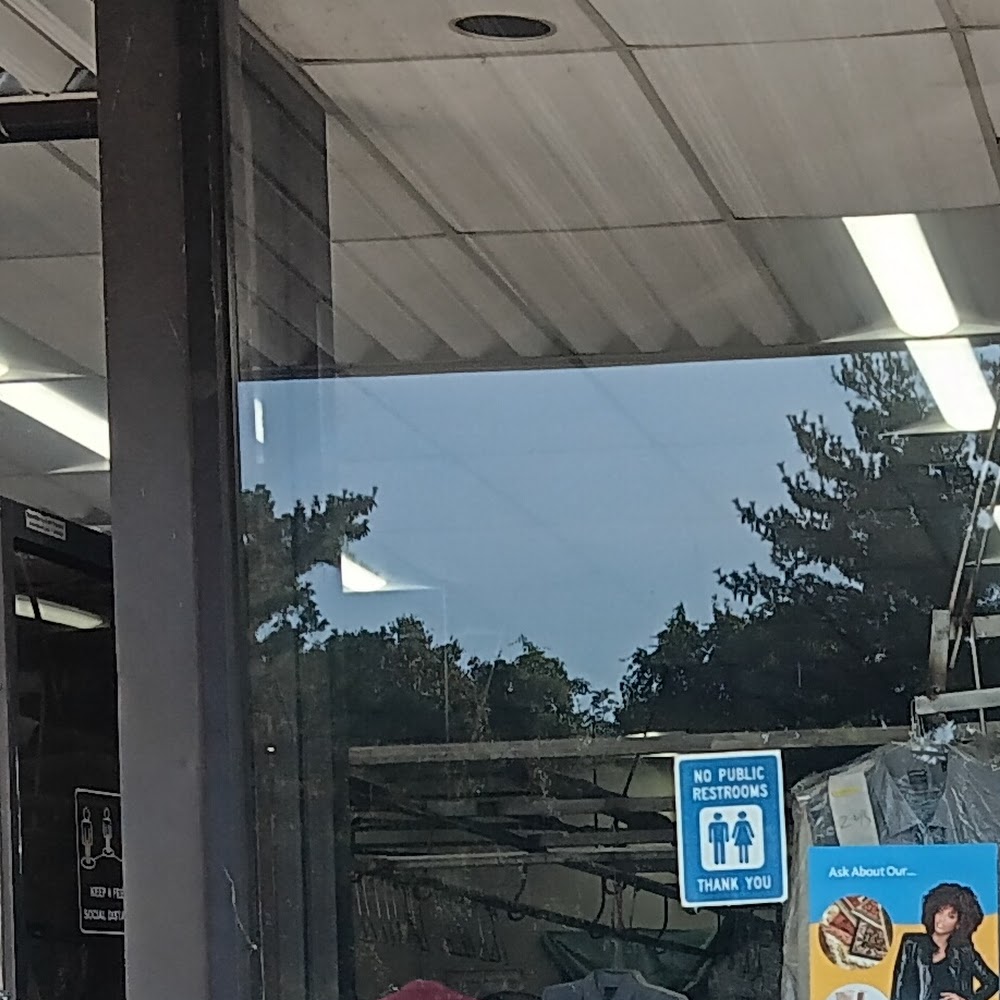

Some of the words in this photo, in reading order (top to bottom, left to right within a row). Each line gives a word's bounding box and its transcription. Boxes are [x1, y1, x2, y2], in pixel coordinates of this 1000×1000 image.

[694, 769, 712, 783] NO
[718, 766, 765, 782] PUBLIC
[692, 784, 768, 801] RESTROOMS
[828, 865, 850, 877] Ask
[851, 865, 886, 877] About
[697, 877, 739, 892] THANK
[744, 875, 772, 890] YOU
